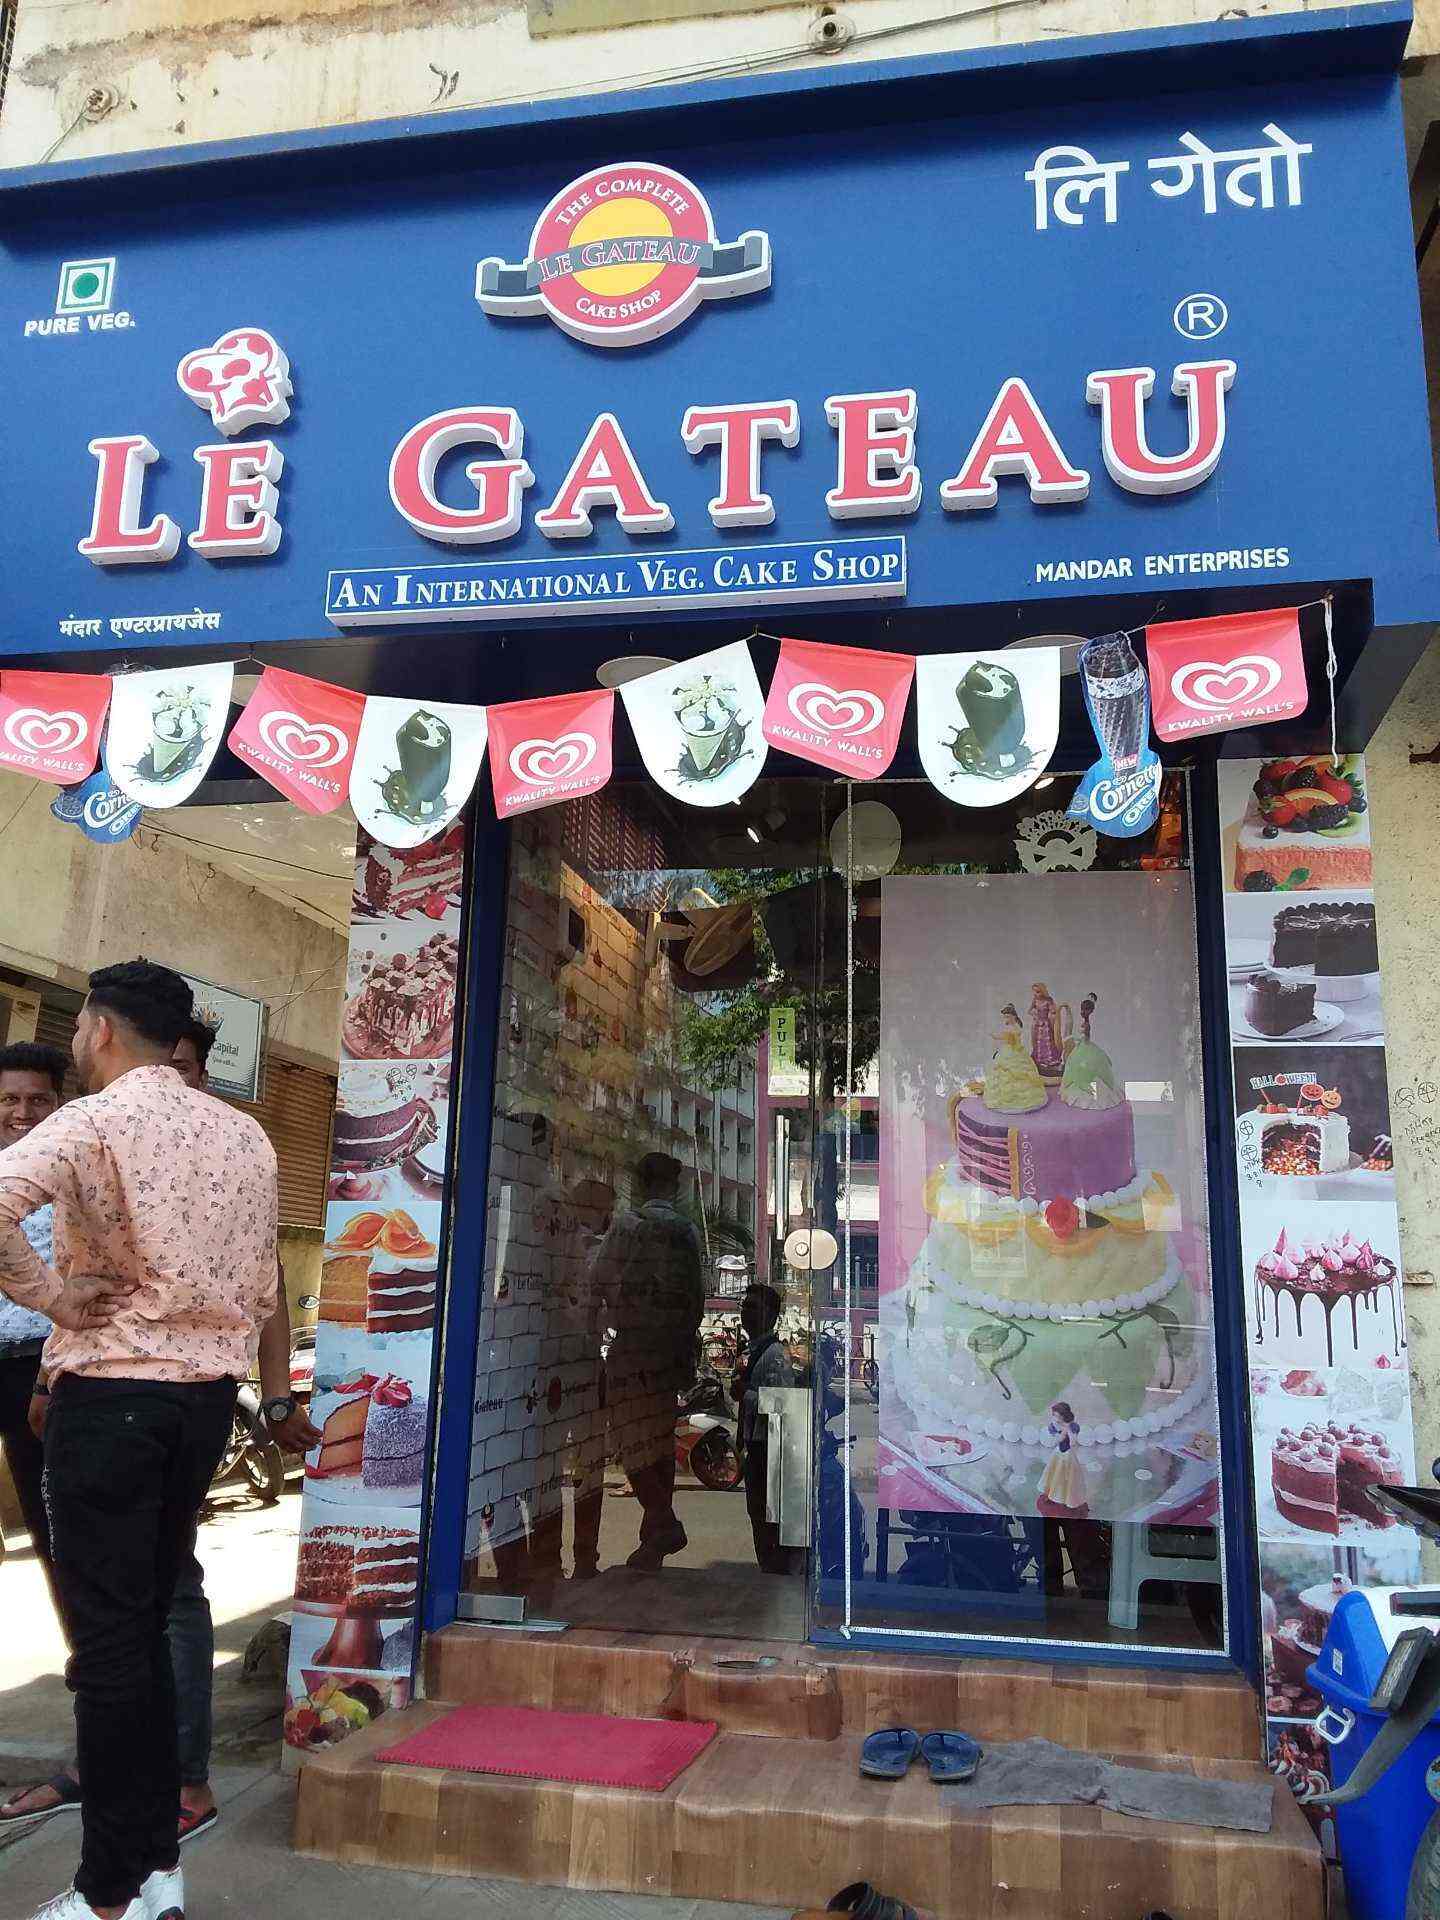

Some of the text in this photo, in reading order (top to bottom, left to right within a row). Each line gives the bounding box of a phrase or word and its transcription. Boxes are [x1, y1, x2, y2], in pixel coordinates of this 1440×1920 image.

[1025, 122, 1312, 230] लि गेतो
[555, 178, 690, 225] THE COMPLETE
[538, 241, 700, 281] LE GATEAU
[575, 290, 662, 319] CAKE SHOP
[24, 311, 136, 336] PURE VEG.
[78, 360, 1238, 560] LE GATEAU
[332, 549, 899, 608] AN INTERNATIONAL VEG. CAKE SHOP
[1036, 548, 1290, 582] MANDAR ENTERPRISES
[59, 613, 102, 637] मंदार
[1168, 701, 1295, 732] KWALITY WALL'S
[772, 725, 884, 759] KWALITY WALL'S
[42, 757, 86, 772] WALL'S
[238, 742, 342, 794] KWALITY WALL'S
[1113, 755, 1137, 769] NEW
[505, 775, 601, 806] KWALITY WALL'S
